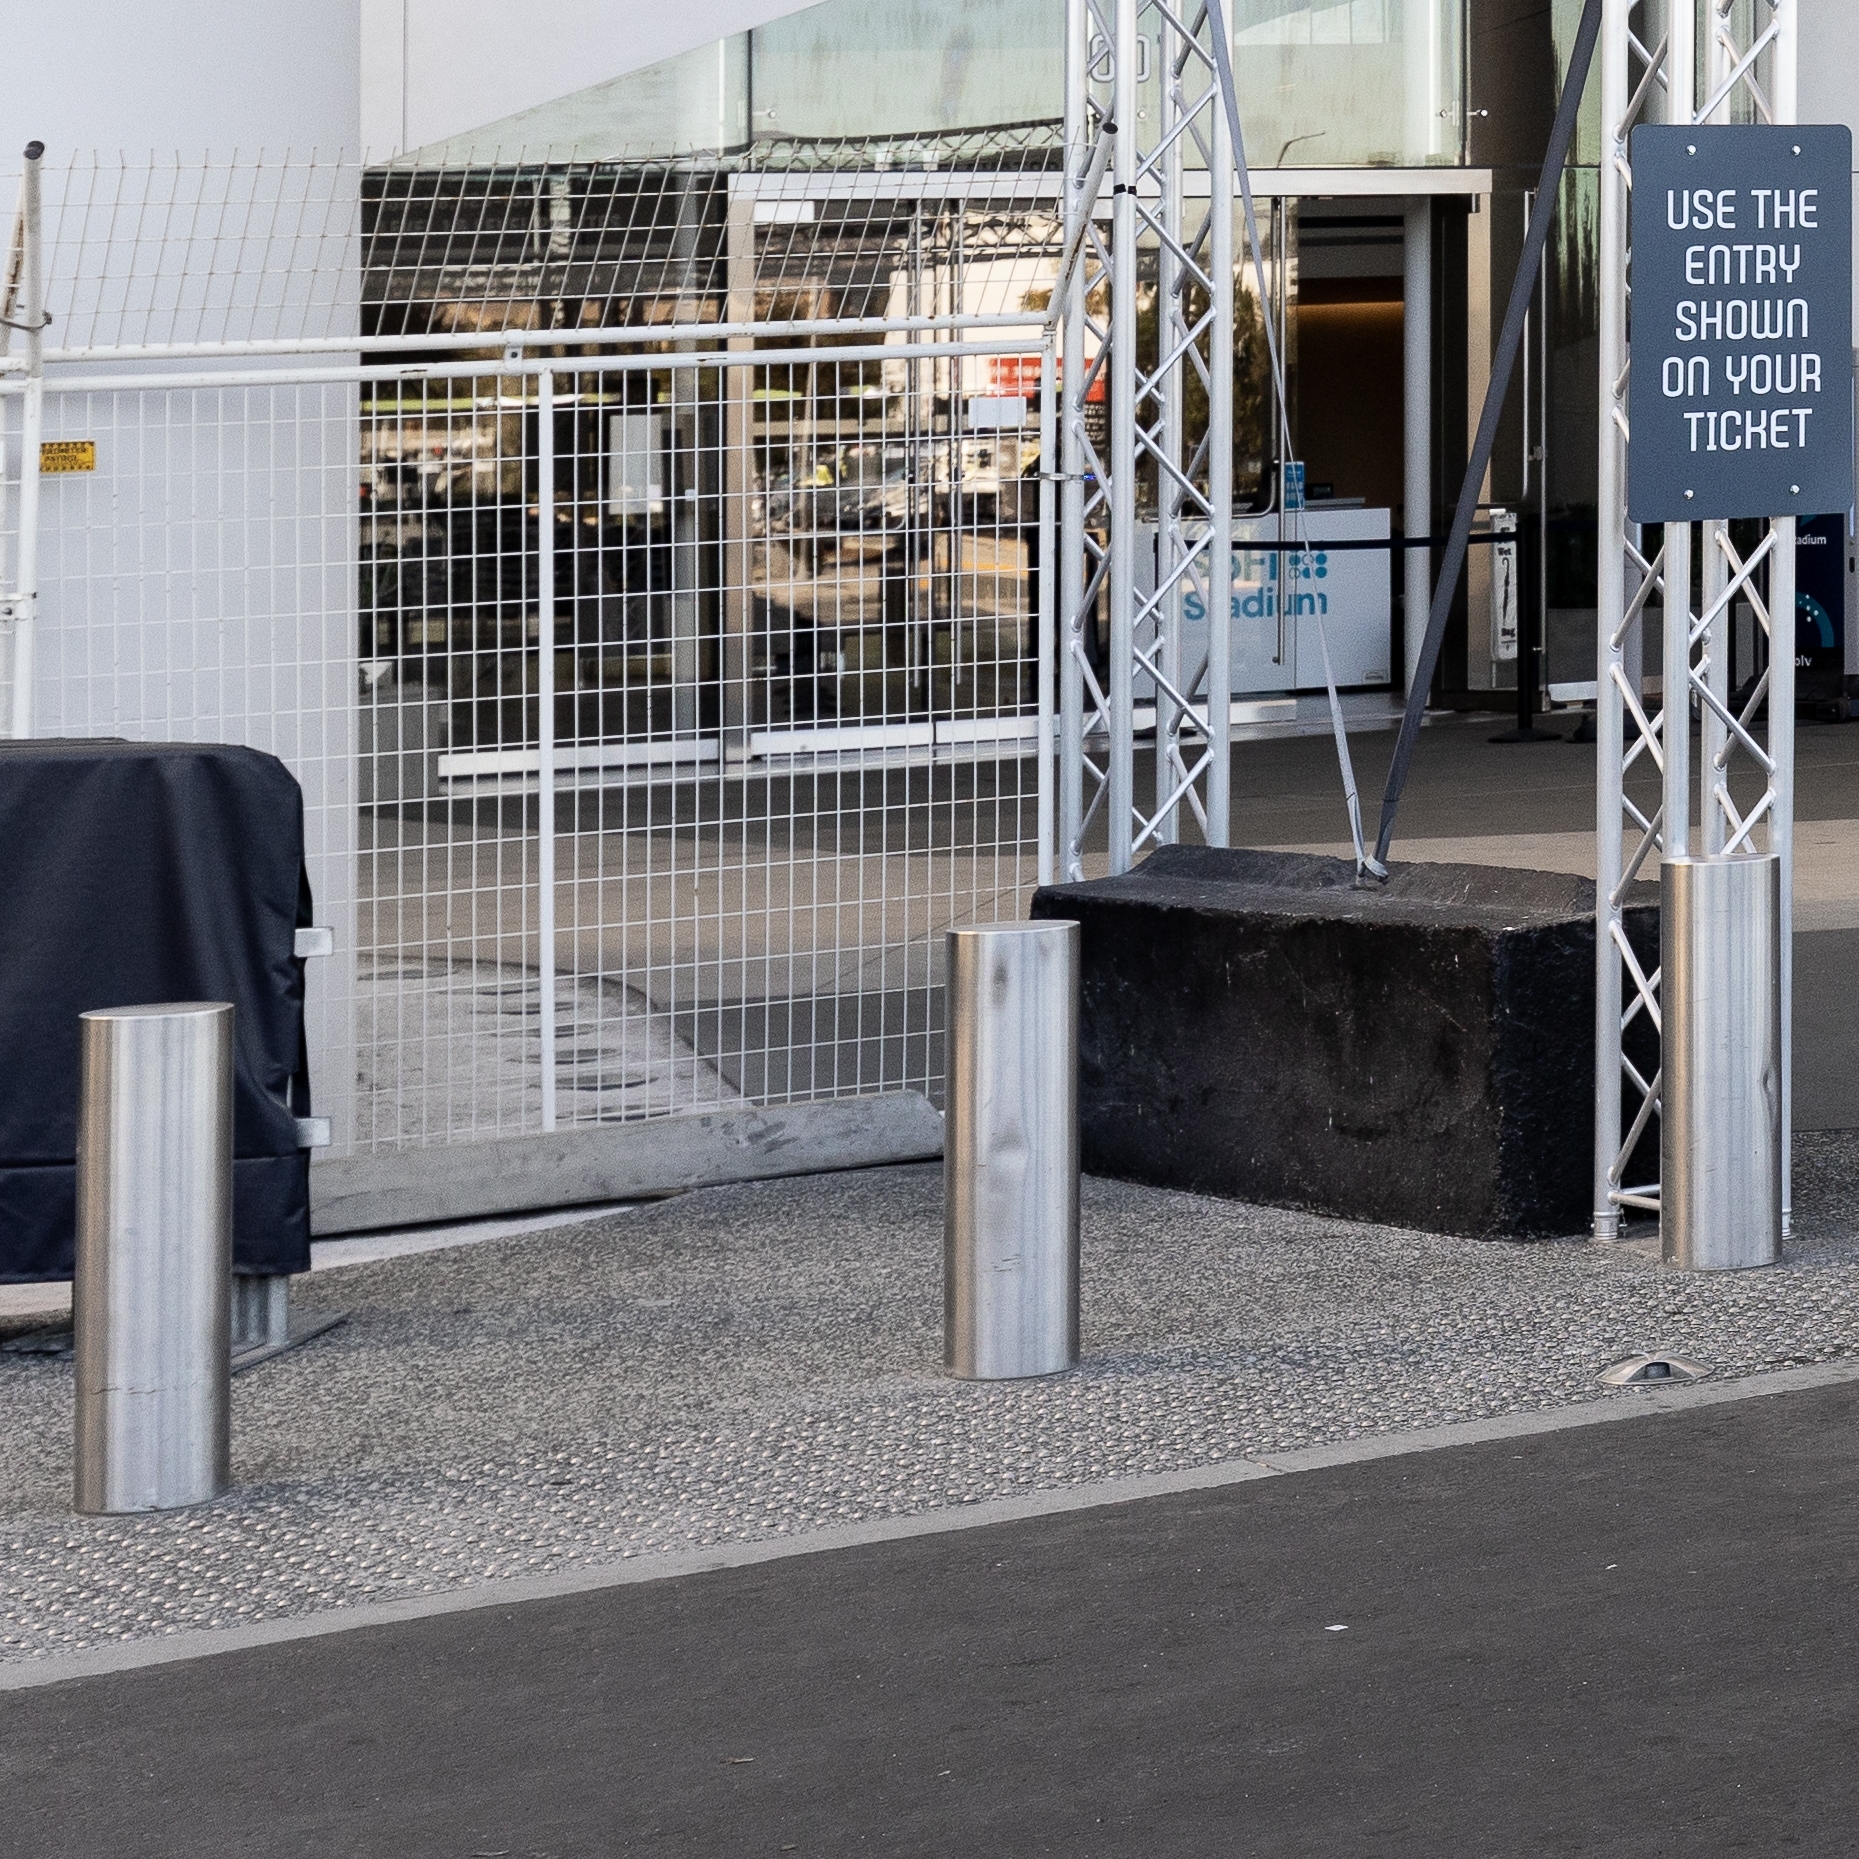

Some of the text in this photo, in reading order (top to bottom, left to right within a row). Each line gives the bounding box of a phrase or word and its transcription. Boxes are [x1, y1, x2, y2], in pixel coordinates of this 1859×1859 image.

[1668, 190, 1818, 229] USE THE
[1686, 245, 1800, 284] ENTRY
[1676, 299, 1808, 341] SHOWN
[1663, 354, 1822, 397] ON YOUR
[1684, 408, 1813, 451] TICKET
[1795, 534, 1827, 544] adium
[1184, 587, 1328, 621] Sadium
[1795, 655, 1812, 666] olv
